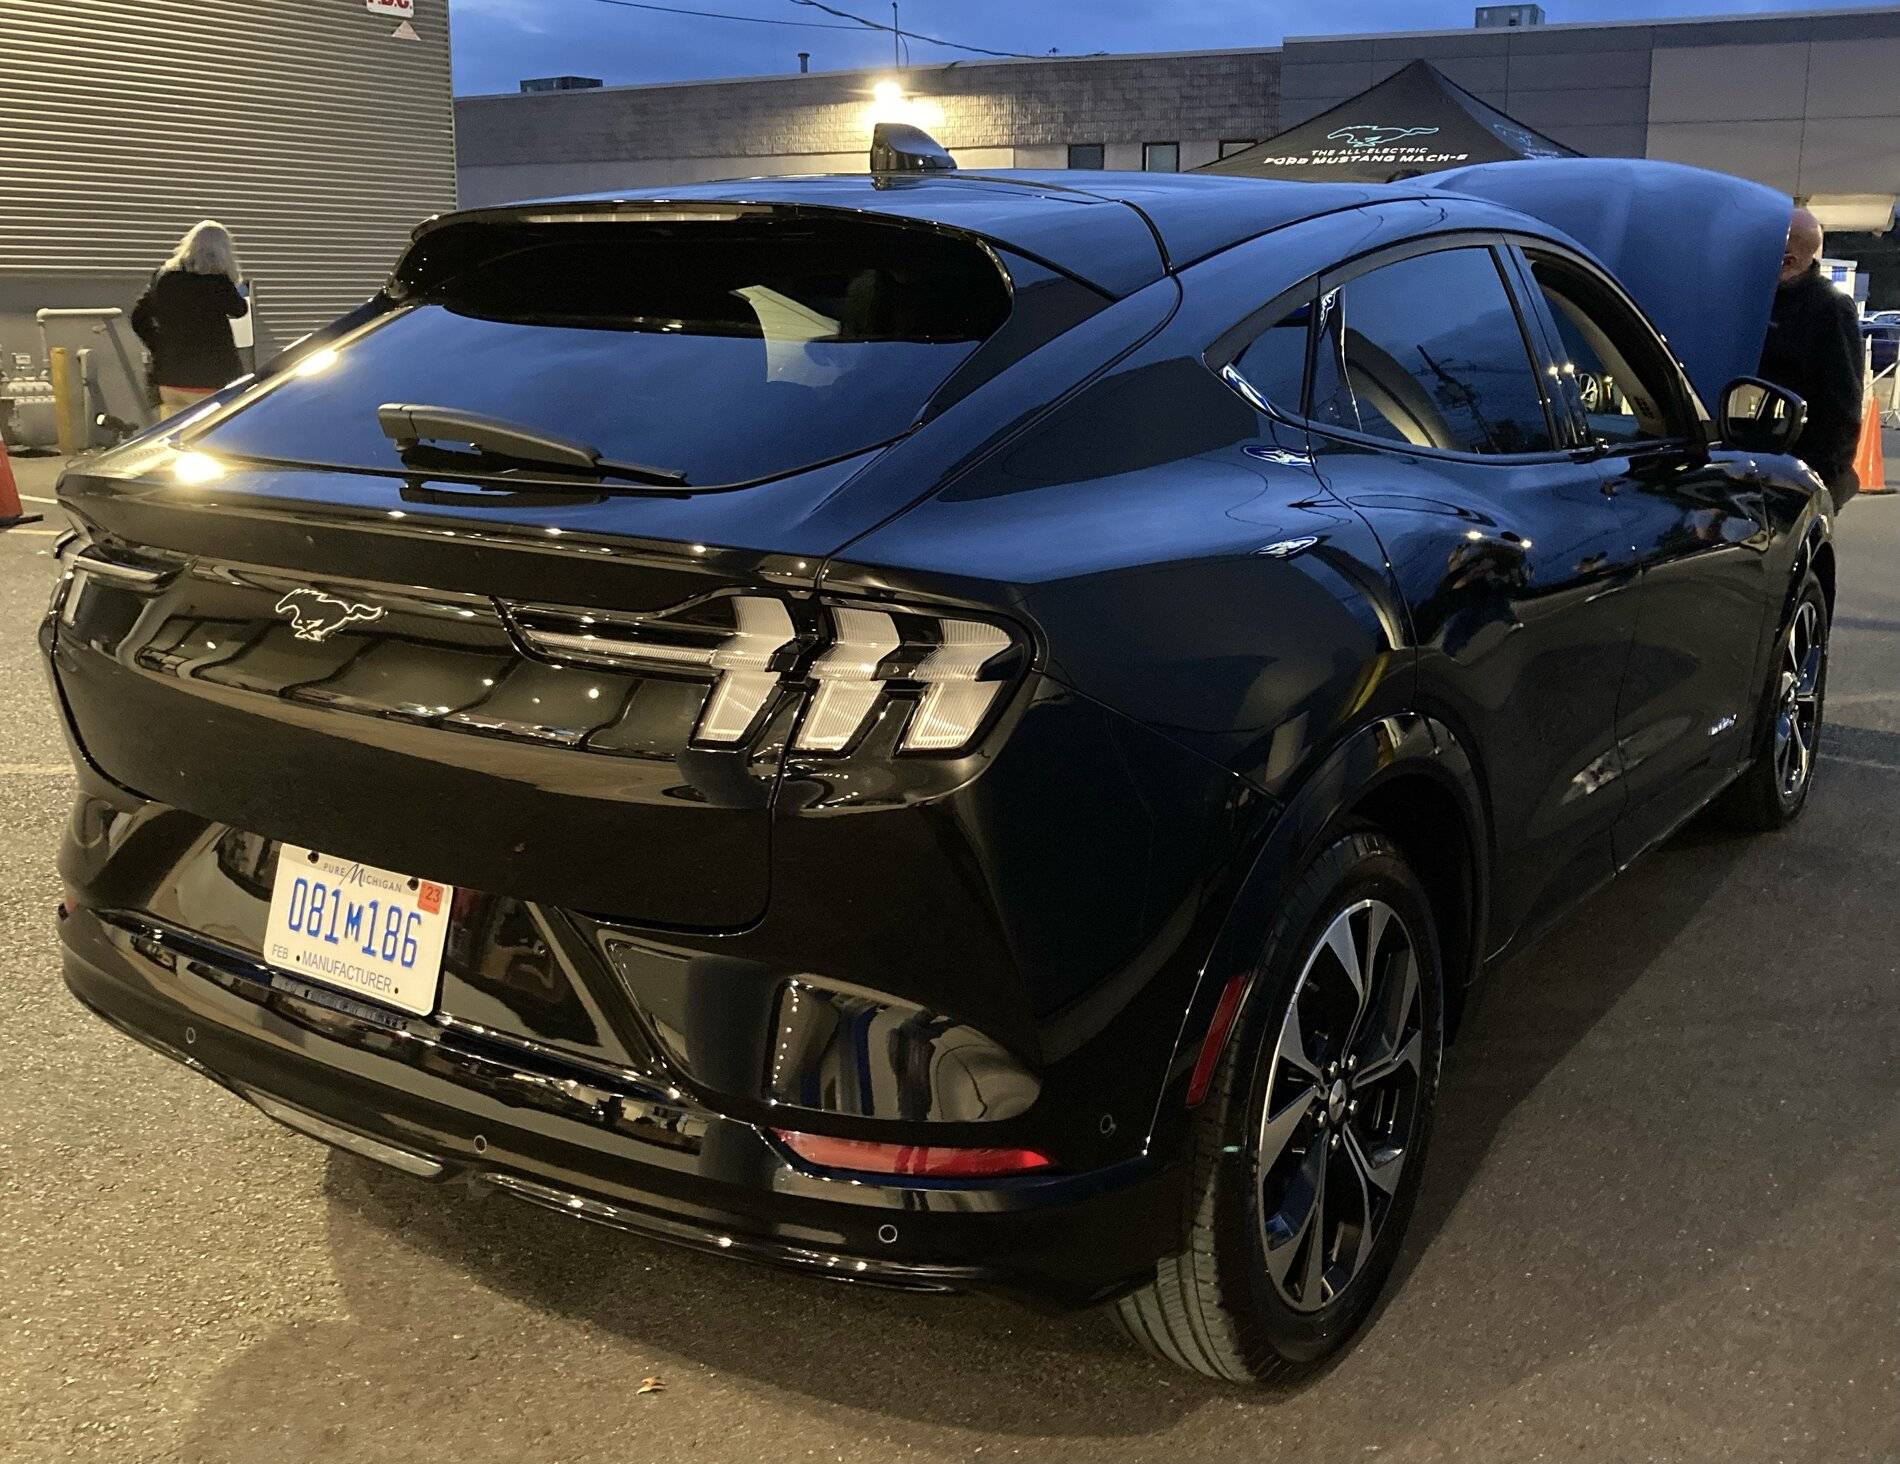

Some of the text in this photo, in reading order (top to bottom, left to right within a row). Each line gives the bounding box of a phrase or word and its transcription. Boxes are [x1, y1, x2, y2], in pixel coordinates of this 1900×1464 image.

[1263, 153, 1469, 165] FORD MUSTANG MACH-E
[1338, 147, 1429, 156] ALL-ELECTRIC
[323, 862, 402, 893] PURE MICHIGAN
[287, 876, 423, 969] 081M186
[272, 943, 289, 960] FEB
[301, 949, 393, 994] MANUFACTURER
